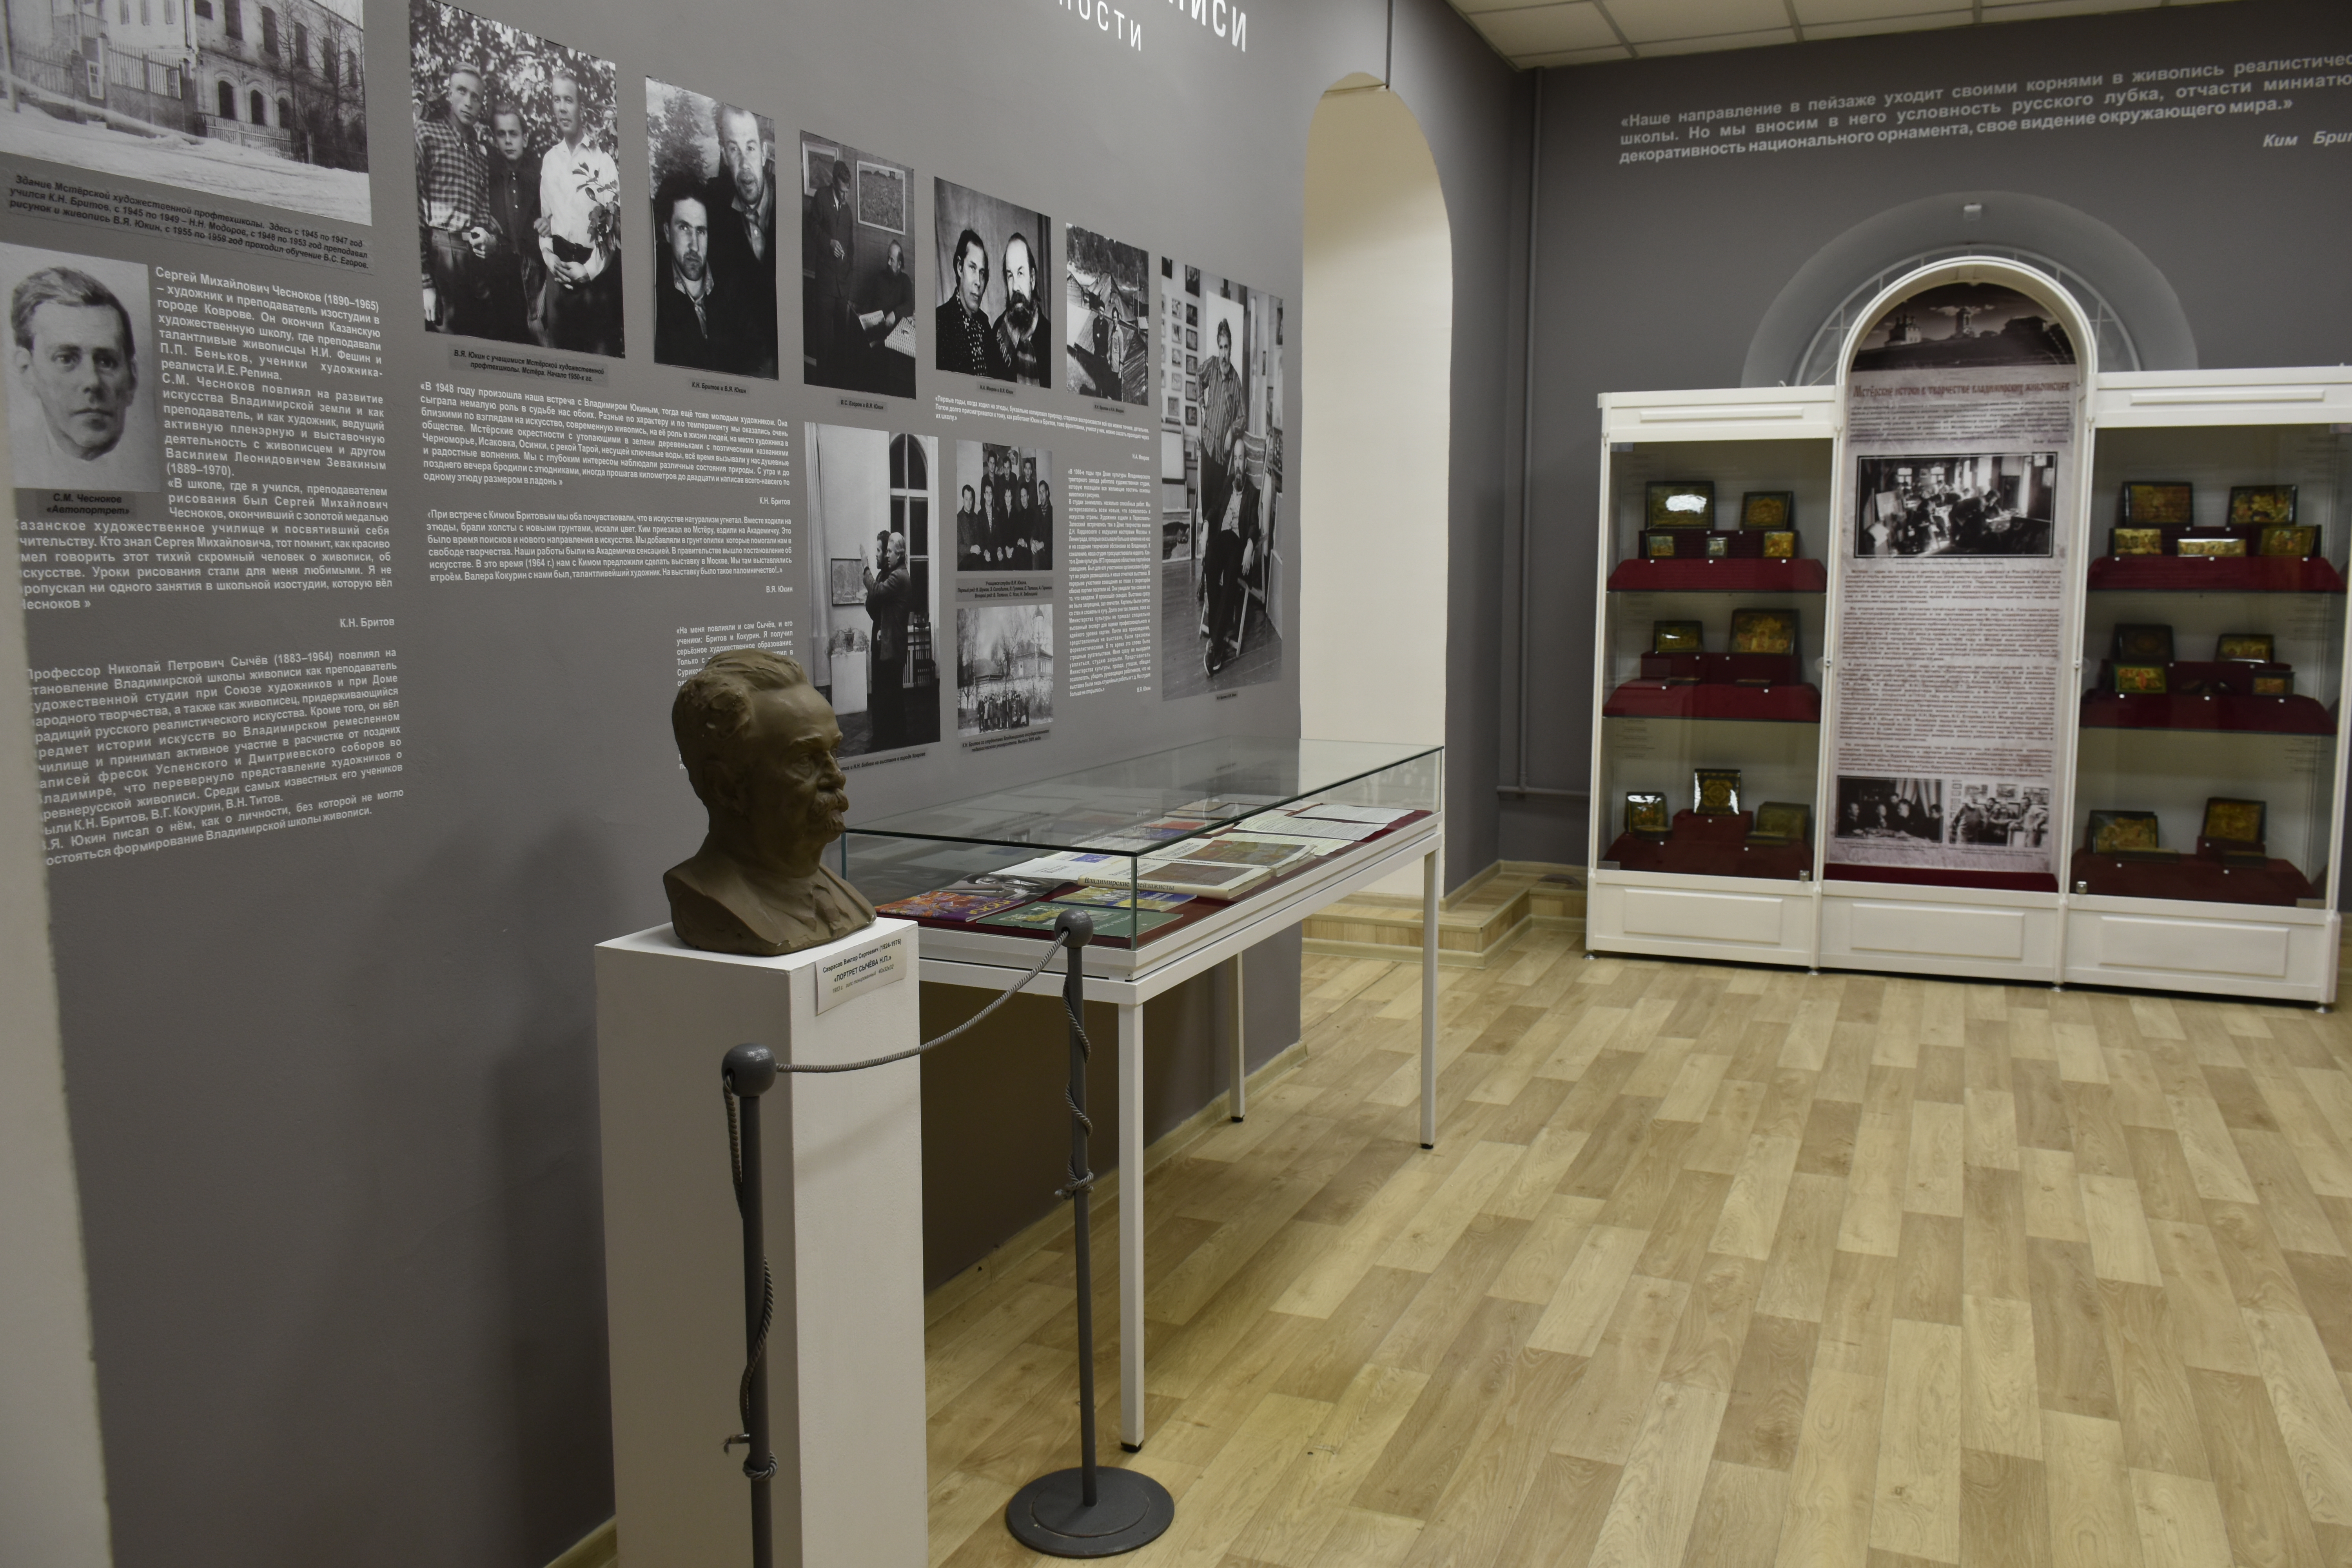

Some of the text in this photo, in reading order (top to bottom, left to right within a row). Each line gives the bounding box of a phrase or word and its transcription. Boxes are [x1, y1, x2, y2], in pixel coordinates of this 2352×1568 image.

[1060, 0, 1141, 51] ОСТИ
[1169, 0, 1247, 52] ИСИ
[1620, 131, 1679, 145] школы.
[1688, 126, 1710, 139] Но
[1720, 125, 1746, 136] мы
[1755, 118, 1818, 134] вносим
[1828, 116, 1839, 127] в
[1848, 112, 1887, 125] него
[1896, 103, 2002, 125] условность
[2012, 94, 2094, 115] русского
[2103, 88, 2164, 106] лубка,
[2175, 82, 2252, 98] отчасти
[1621, 113, 1671, 127] «Наше
[1678, 103, 1782, 123] направление
[1790, 102, 1800, 113] в
[1808, 95, 1877, 111] пейзаже
[1884, 89, 1944, 107] уходит
[1951, 82, 2018, 98] своими
[2026, 75, 2103, 93] корнями
[2112, 73, 2123, 84] в
[2132, 65, 2225, 83] живопись
[1619, 99, 2294, 165] декоративность национального орнамента, свое видение окружающего мира.»
[2262, 133, 2299, 147] Ким
[10, 189, 45, 199] учился
[49, 194, 67, 203] К.Н.
[71, 197, 109, 211] Бритов,
[123, 207, 143, 216] 1945
[160, 214, 179, 223] 1949
[189, 218, 205, 227] Н.Н.
[209, 222, 248, 236] Модоров,
[258, 231, 275, 240] 1948
[290, 238, 306, 246] 1953
[324, 245, 367, 258] преподавал
[16, 175, 51, 189] Здание
[55, 182, 110, 199] Мстёрской
[113, 195, 191, 214] художественной
[194, 210, 264, 228] профтехшколы.
[269, 223, 292, 234] Здесь
[301, 229, 318, 238] 1945
[332, 236, 348, 244] 1947
[156, 267, 379, 313] Сергей Михайлович Чесноков (1890–1965)
[167, 286, 223, 301] художник
[237, 296, 318, 315] преподаватель
[321, 309, 371, 323] изостудии
[157, 299, 380, 338] городе Коврове. Он окончил Казанскую
[158, 315, 381, 351] художественную школу, где преподавали
[420, 381, 432, 390] «В
[436, 383, 454, 393] 1948
[457, 387, 475, 397] году
[478, 389, 522, 399] произошла
[546, 396, 575, 406] встреча
[584, 398, 627, 411] Владимиром
[630, 403, 660, 415] Юкиным,
[681, 410, 693, 418] ещё
[740, 417, 775, 425] художником.
[46, 505, 130, 517] «Автопортрет»
[53, 493, 122, 503] С.М. Чесноков
[771, 497, 790, 506] Бритов
[340, 617, 394, 629] К.Н. Бритов
[108, 661, 161, 674] Николай
[168, 660, 224, 671] Петрович
[230, 655, 268, 666] Сычёв
[274, 652, 333, 666] (1883–1964)
[338, 651, 380, 660] повлиял
[45, 795, 283, 834] ыли К.Н. Бритов, В.Г. Кокурин, В.Н. Титов.
[1085, 877, 1129, 887] Владимирские
[823, 938, 902, 973] Саврасов Виктор Сергеевич (1924-1976)
[834, 955, 891, 982] «ПОРТРЕТ СЫЧЁВА Н.П.»
